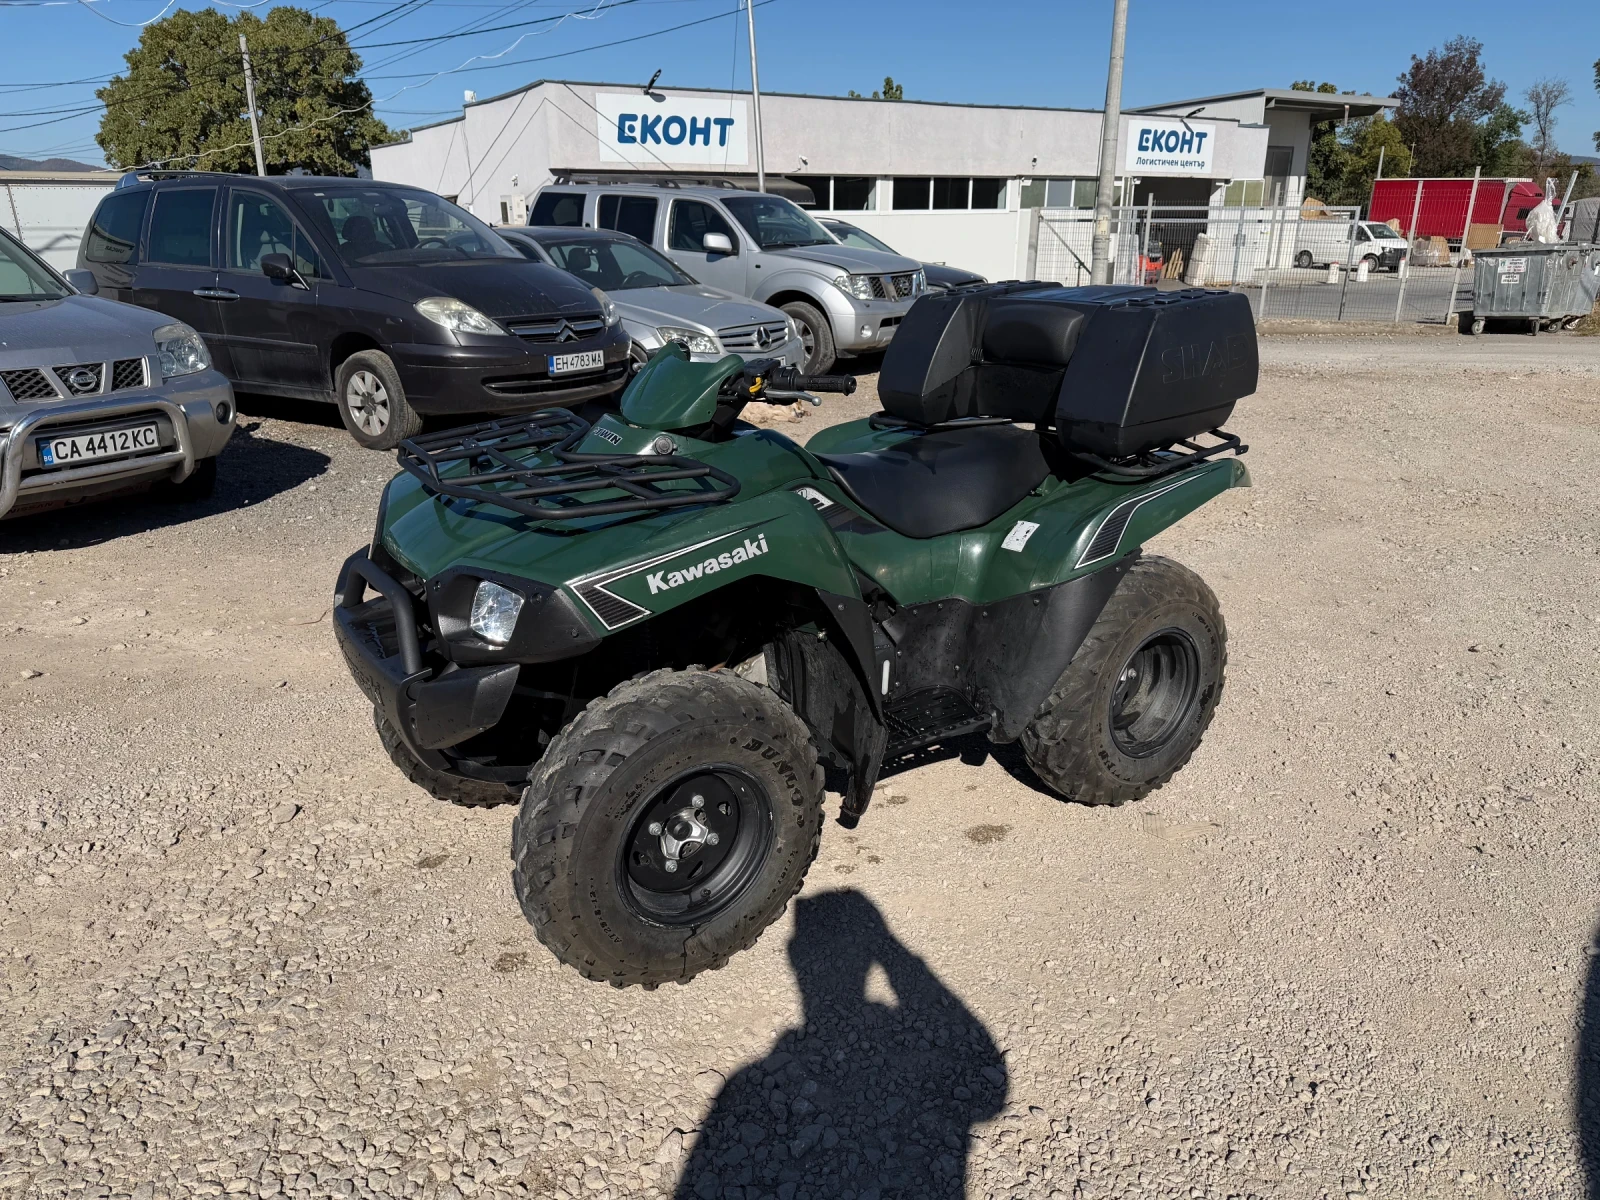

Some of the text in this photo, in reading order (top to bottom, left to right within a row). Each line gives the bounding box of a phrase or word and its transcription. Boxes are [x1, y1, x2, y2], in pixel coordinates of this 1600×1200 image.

[617, 113, 735, 147] ЕКОНТ
[1137, 128, 1208, 154] ЕКОНТ
[1136, 156, 1206, 169] Логистичен център
[646, 533, 769, 595] Kawasaki
